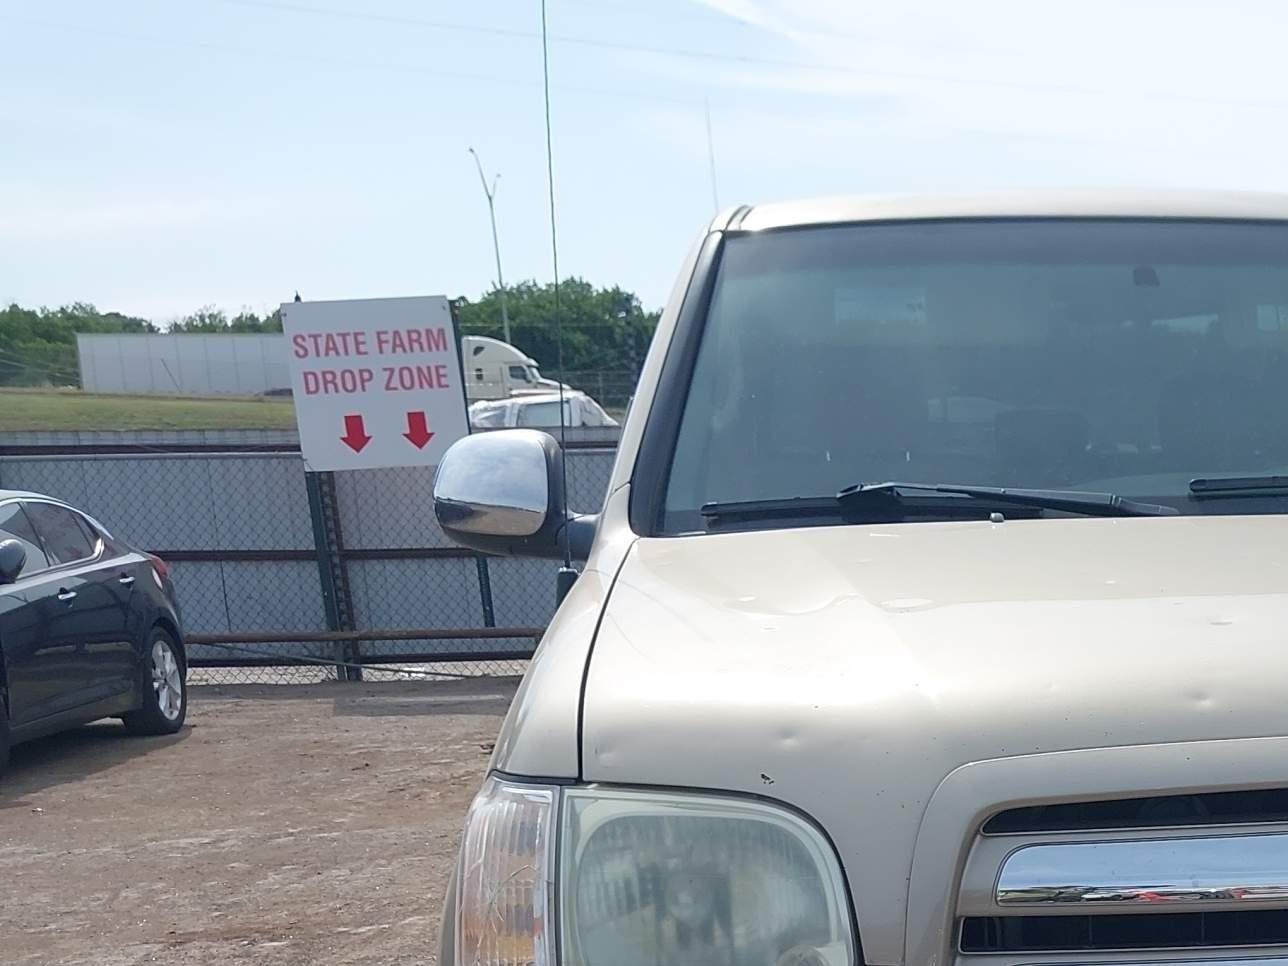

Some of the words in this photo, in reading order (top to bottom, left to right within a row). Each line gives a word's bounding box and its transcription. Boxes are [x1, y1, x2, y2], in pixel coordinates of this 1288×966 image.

[292, 331, 369, 359] STATE
[375, 327, 449, 355] FARM
[303, 368, 374, 396] DROP
[382, 364, 450, 392] ZONE
